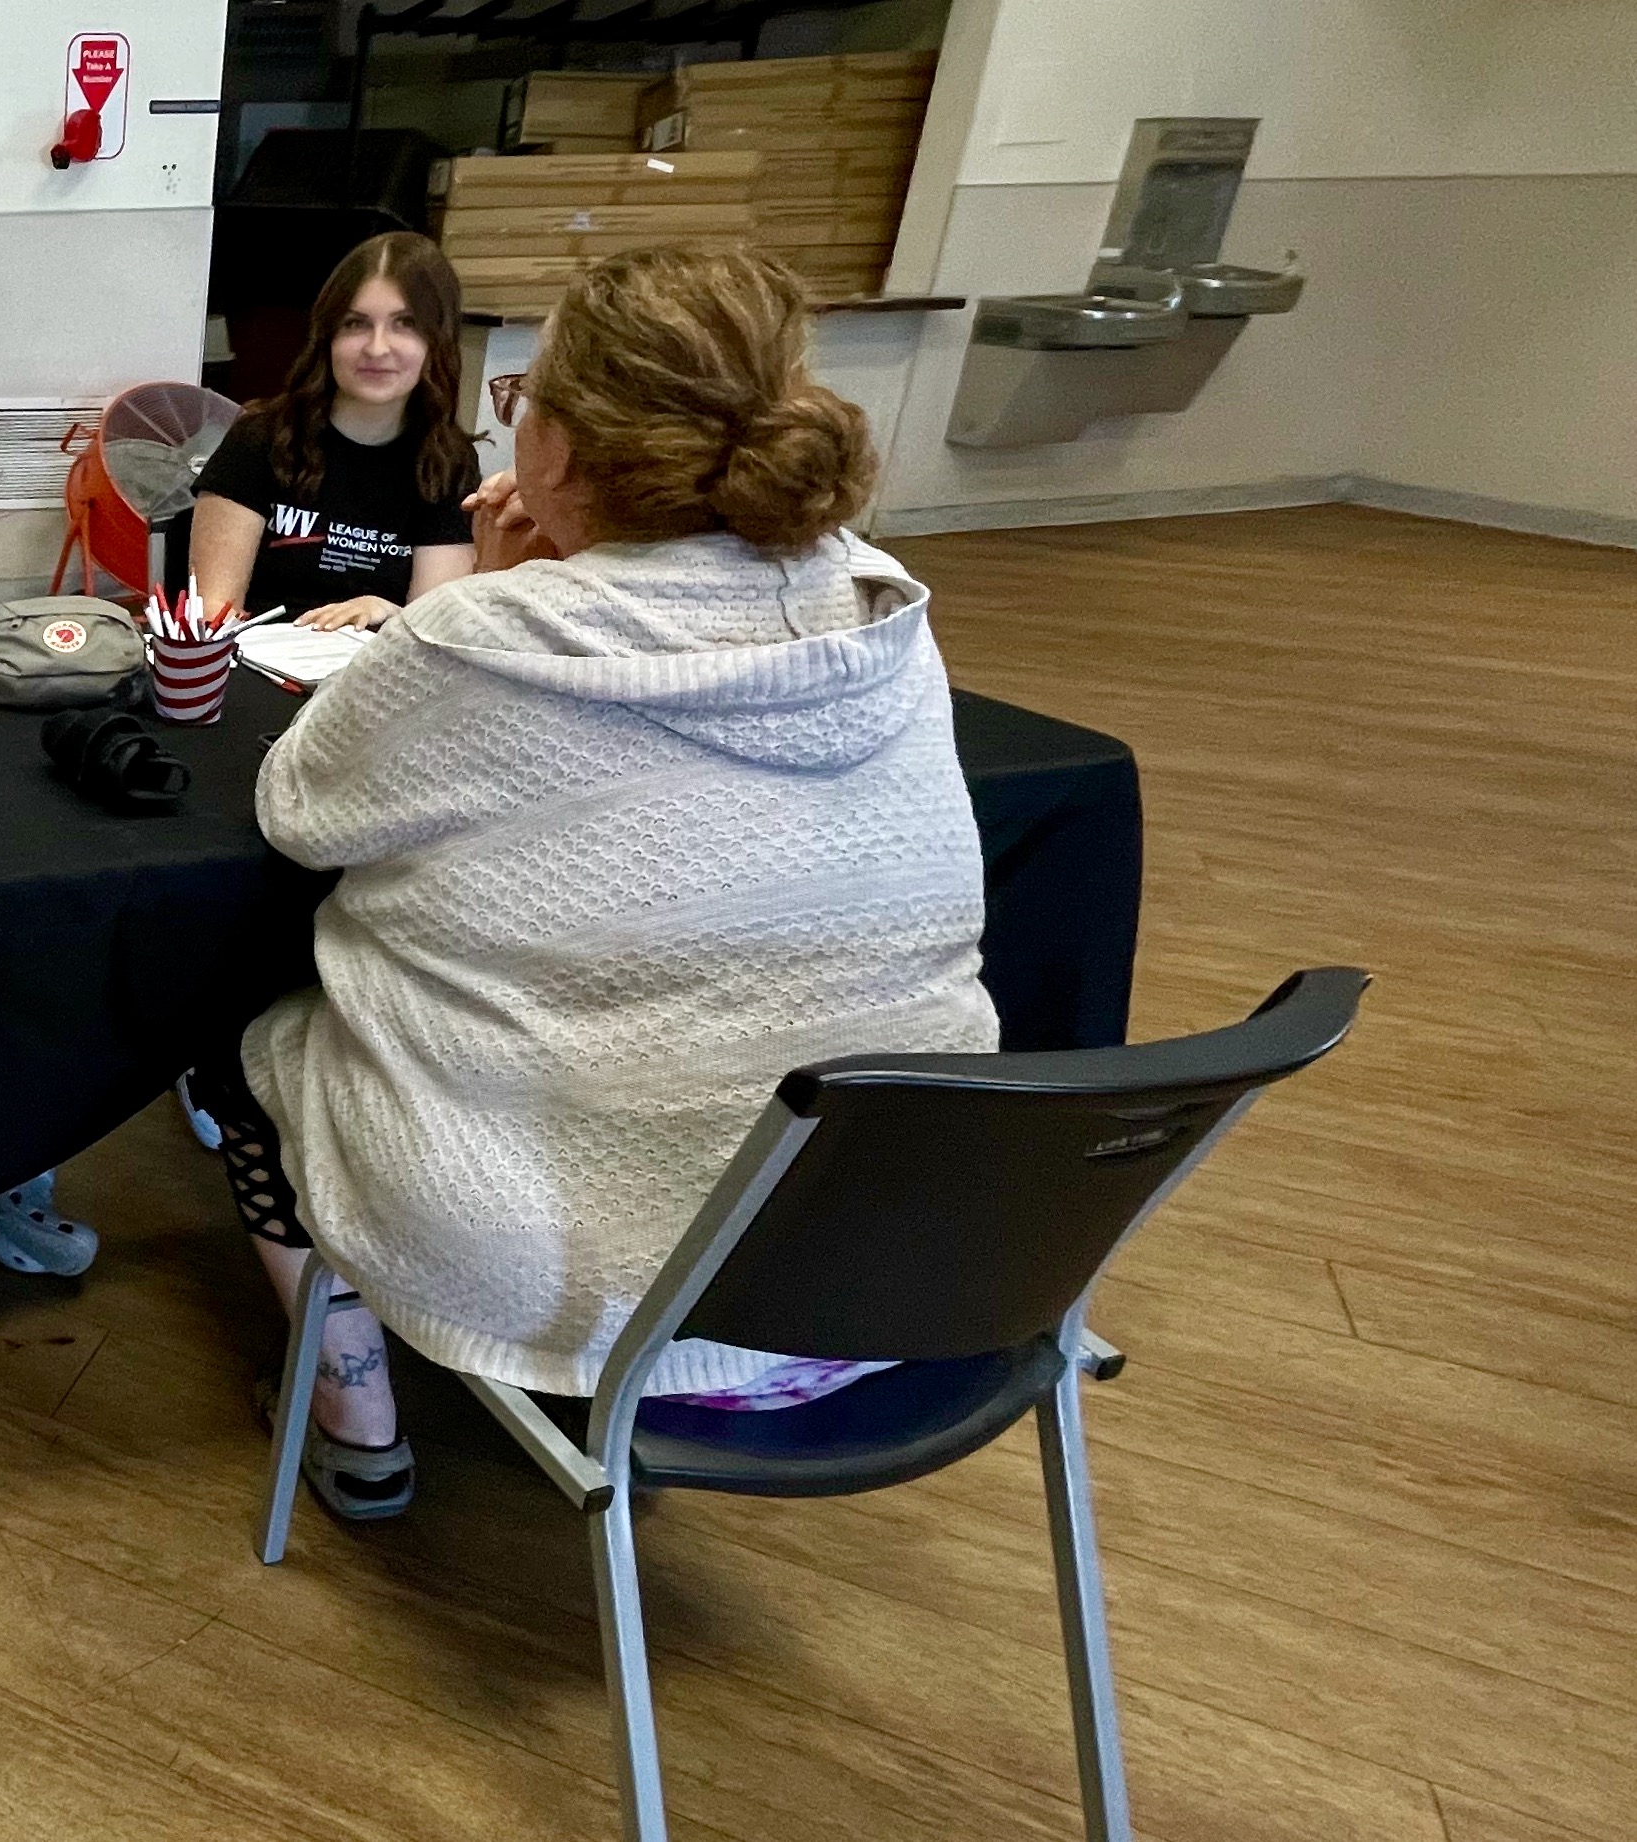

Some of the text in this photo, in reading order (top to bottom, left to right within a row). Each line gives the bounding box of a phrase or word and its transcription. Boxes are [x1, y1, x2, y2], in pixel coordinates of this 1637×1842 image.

[82, 49, 114, 58] PLEASE
[86, 62, 111, 70] Take A
[328, 521, 398, 543] LEAGUE OF
[327, 533, 378, 553] WOMEN
